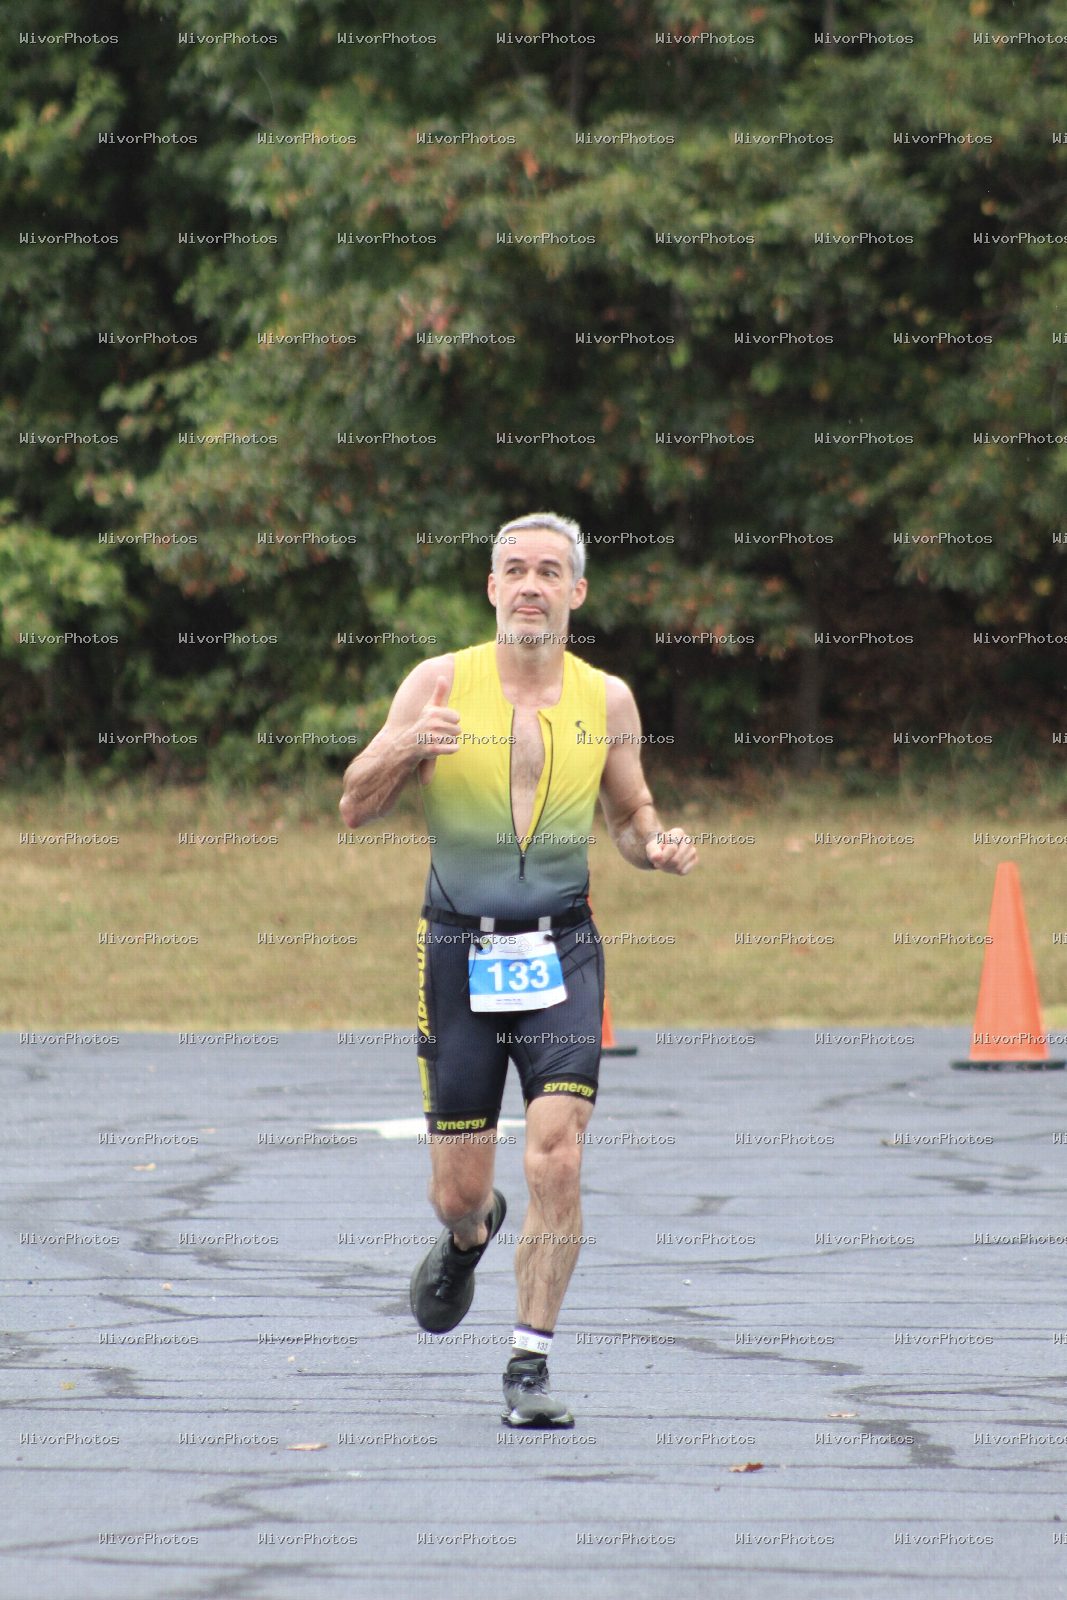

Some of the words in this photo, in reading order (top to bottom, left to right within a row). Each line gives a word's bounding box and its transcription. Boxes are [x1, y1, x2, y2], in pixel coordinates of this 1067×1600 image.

[487, 960, 549, 991] 133
[543, 1082, 594, 1097] synergy
[436, 1118, 487, 1130] synergy
